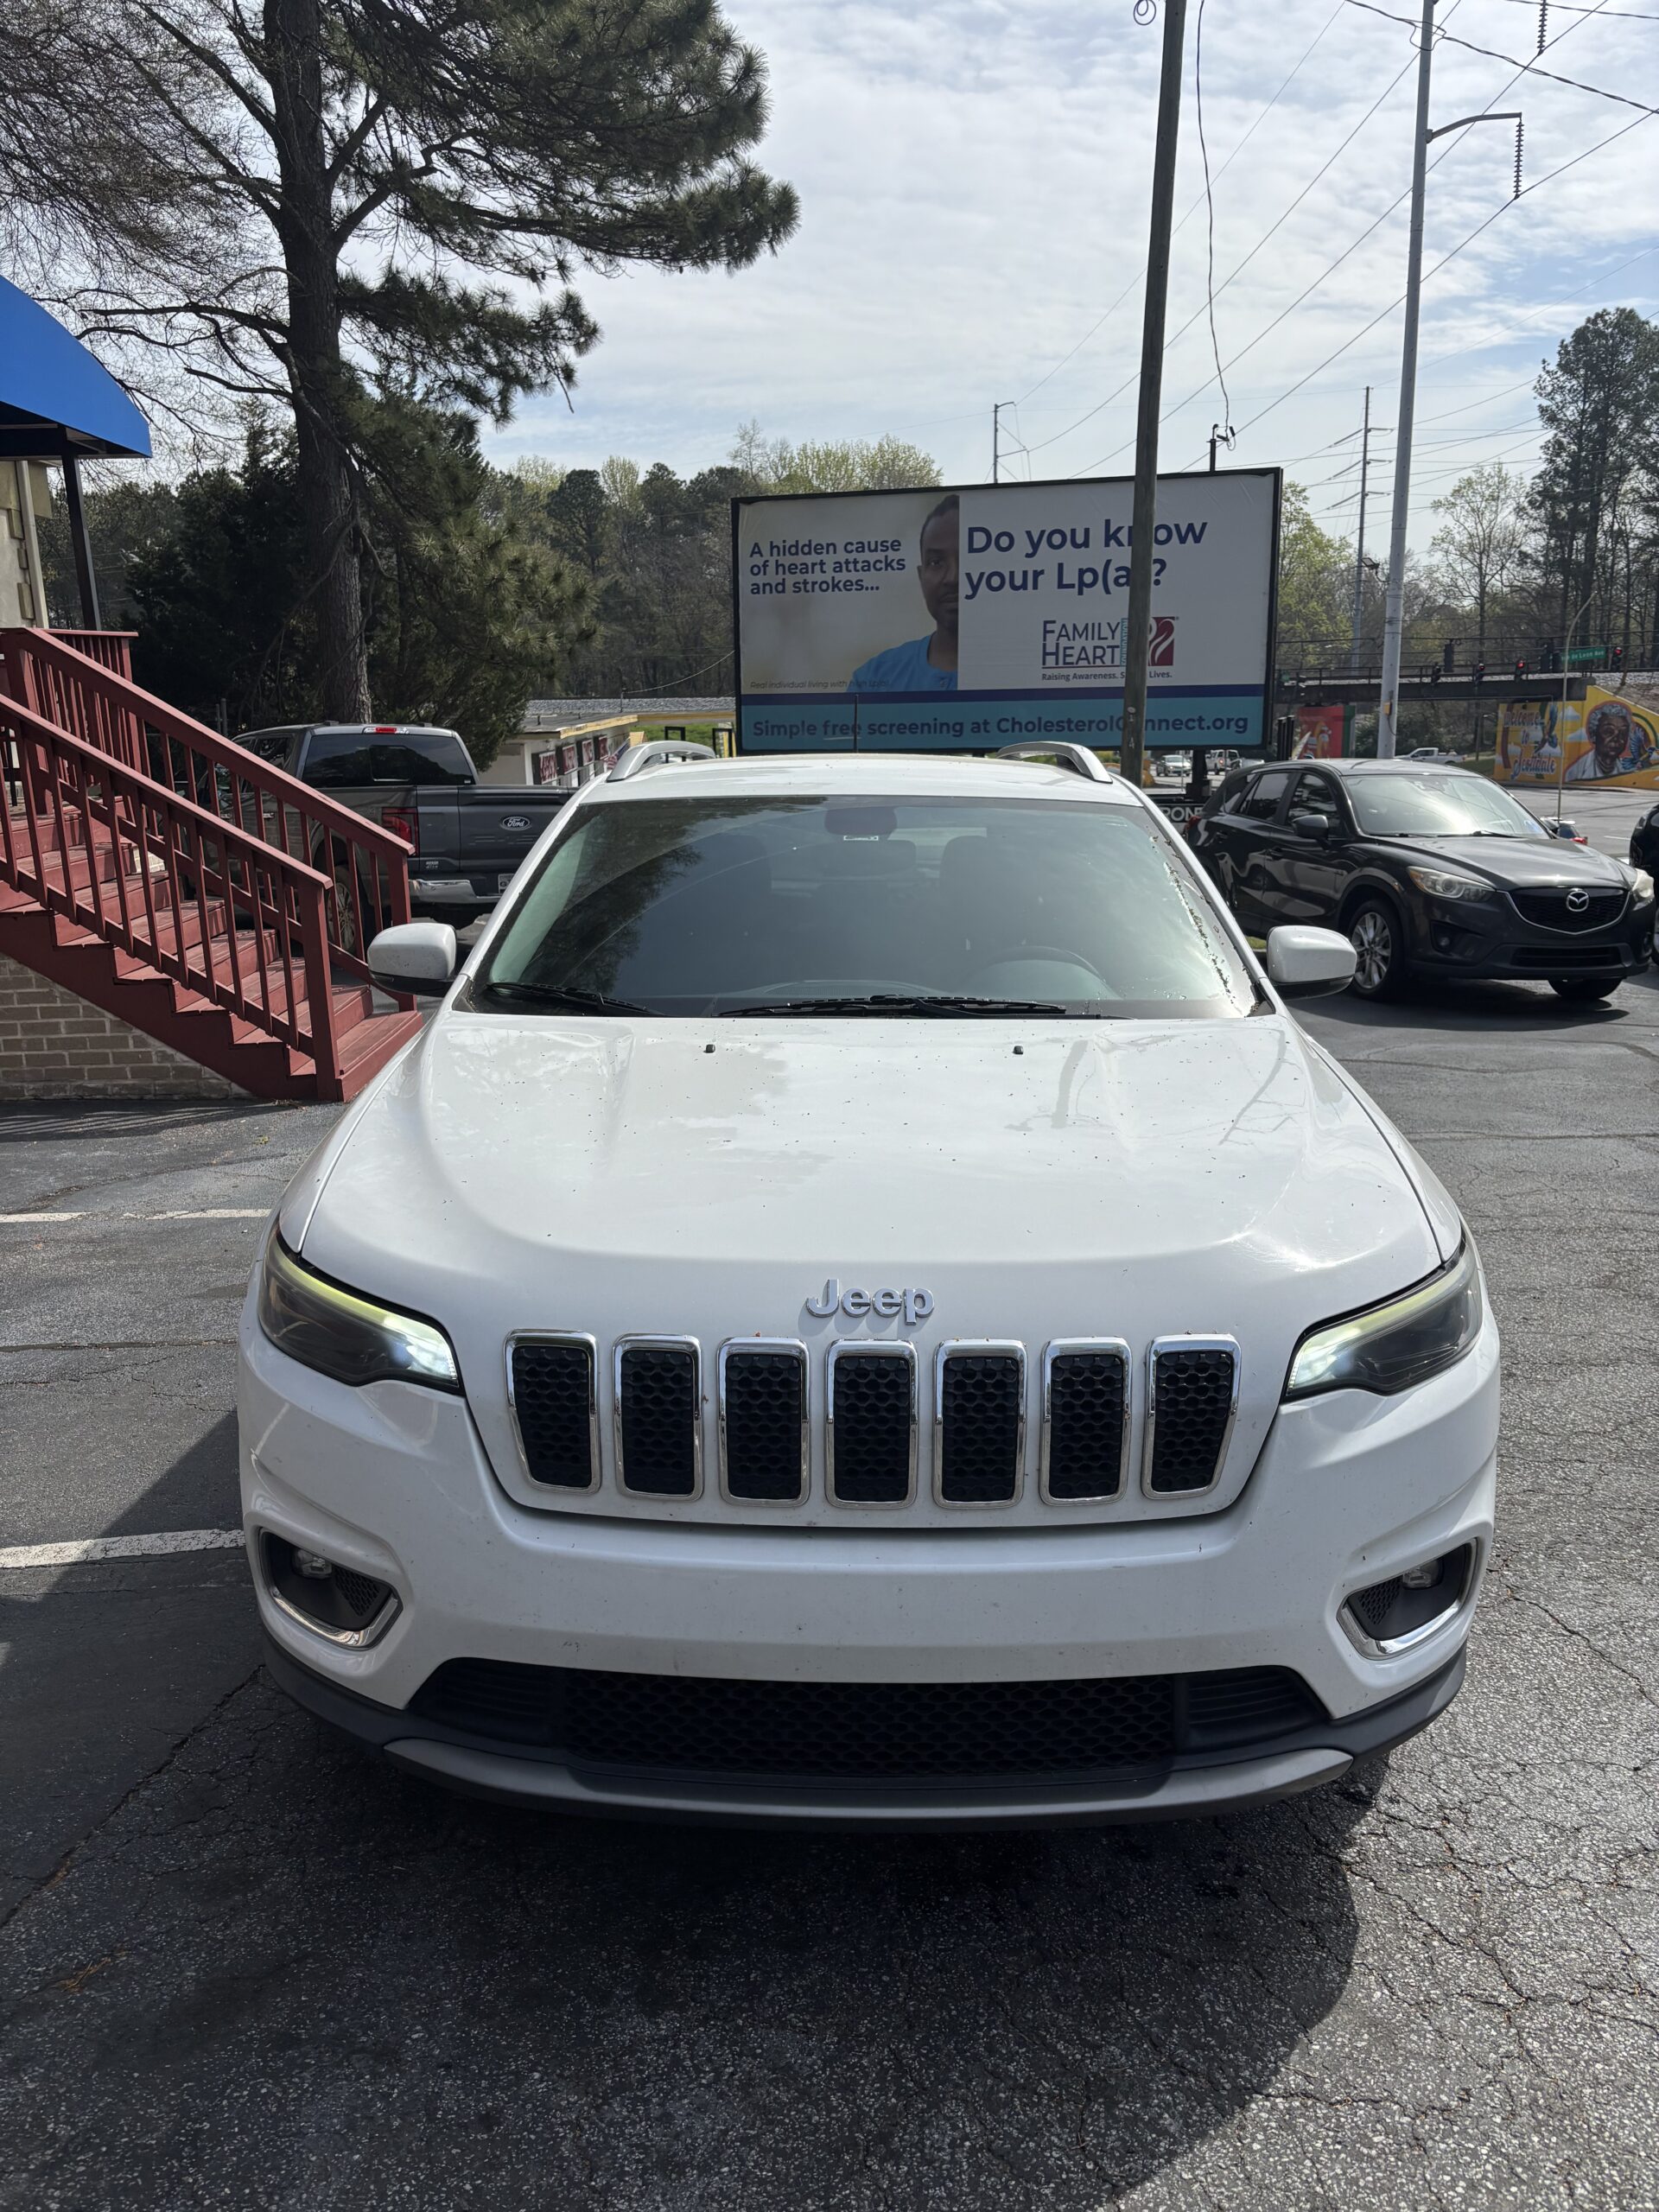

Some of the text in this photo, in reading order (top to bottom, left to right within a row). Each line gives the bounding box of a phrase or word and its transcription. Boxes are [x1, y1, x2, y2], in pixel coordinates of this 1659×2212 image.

[749, 538, 902, 558] A hidden cause
[967, 518, 1208, 558] Do you kow
[749, 556, 906, 576] of heart attacks
[750, 575, 880, 594] and strokes...
[963, 558, 1166, 601] your Lp(a?
[1042, 620, 1122, 642] FAMILY
[1041, 642, 1121, 666] HEART
[1041, 673, 1071, 683] Raising
[1149, 671, 1173, 679] Lives.
[807, 681, 829, 690] living
[753, 715, 1249, 740] Simple free screening at CholesterolCnnect.org
[506, 817, 526, 828] Ford
[805, 1278, 935, 1326] Jeep
